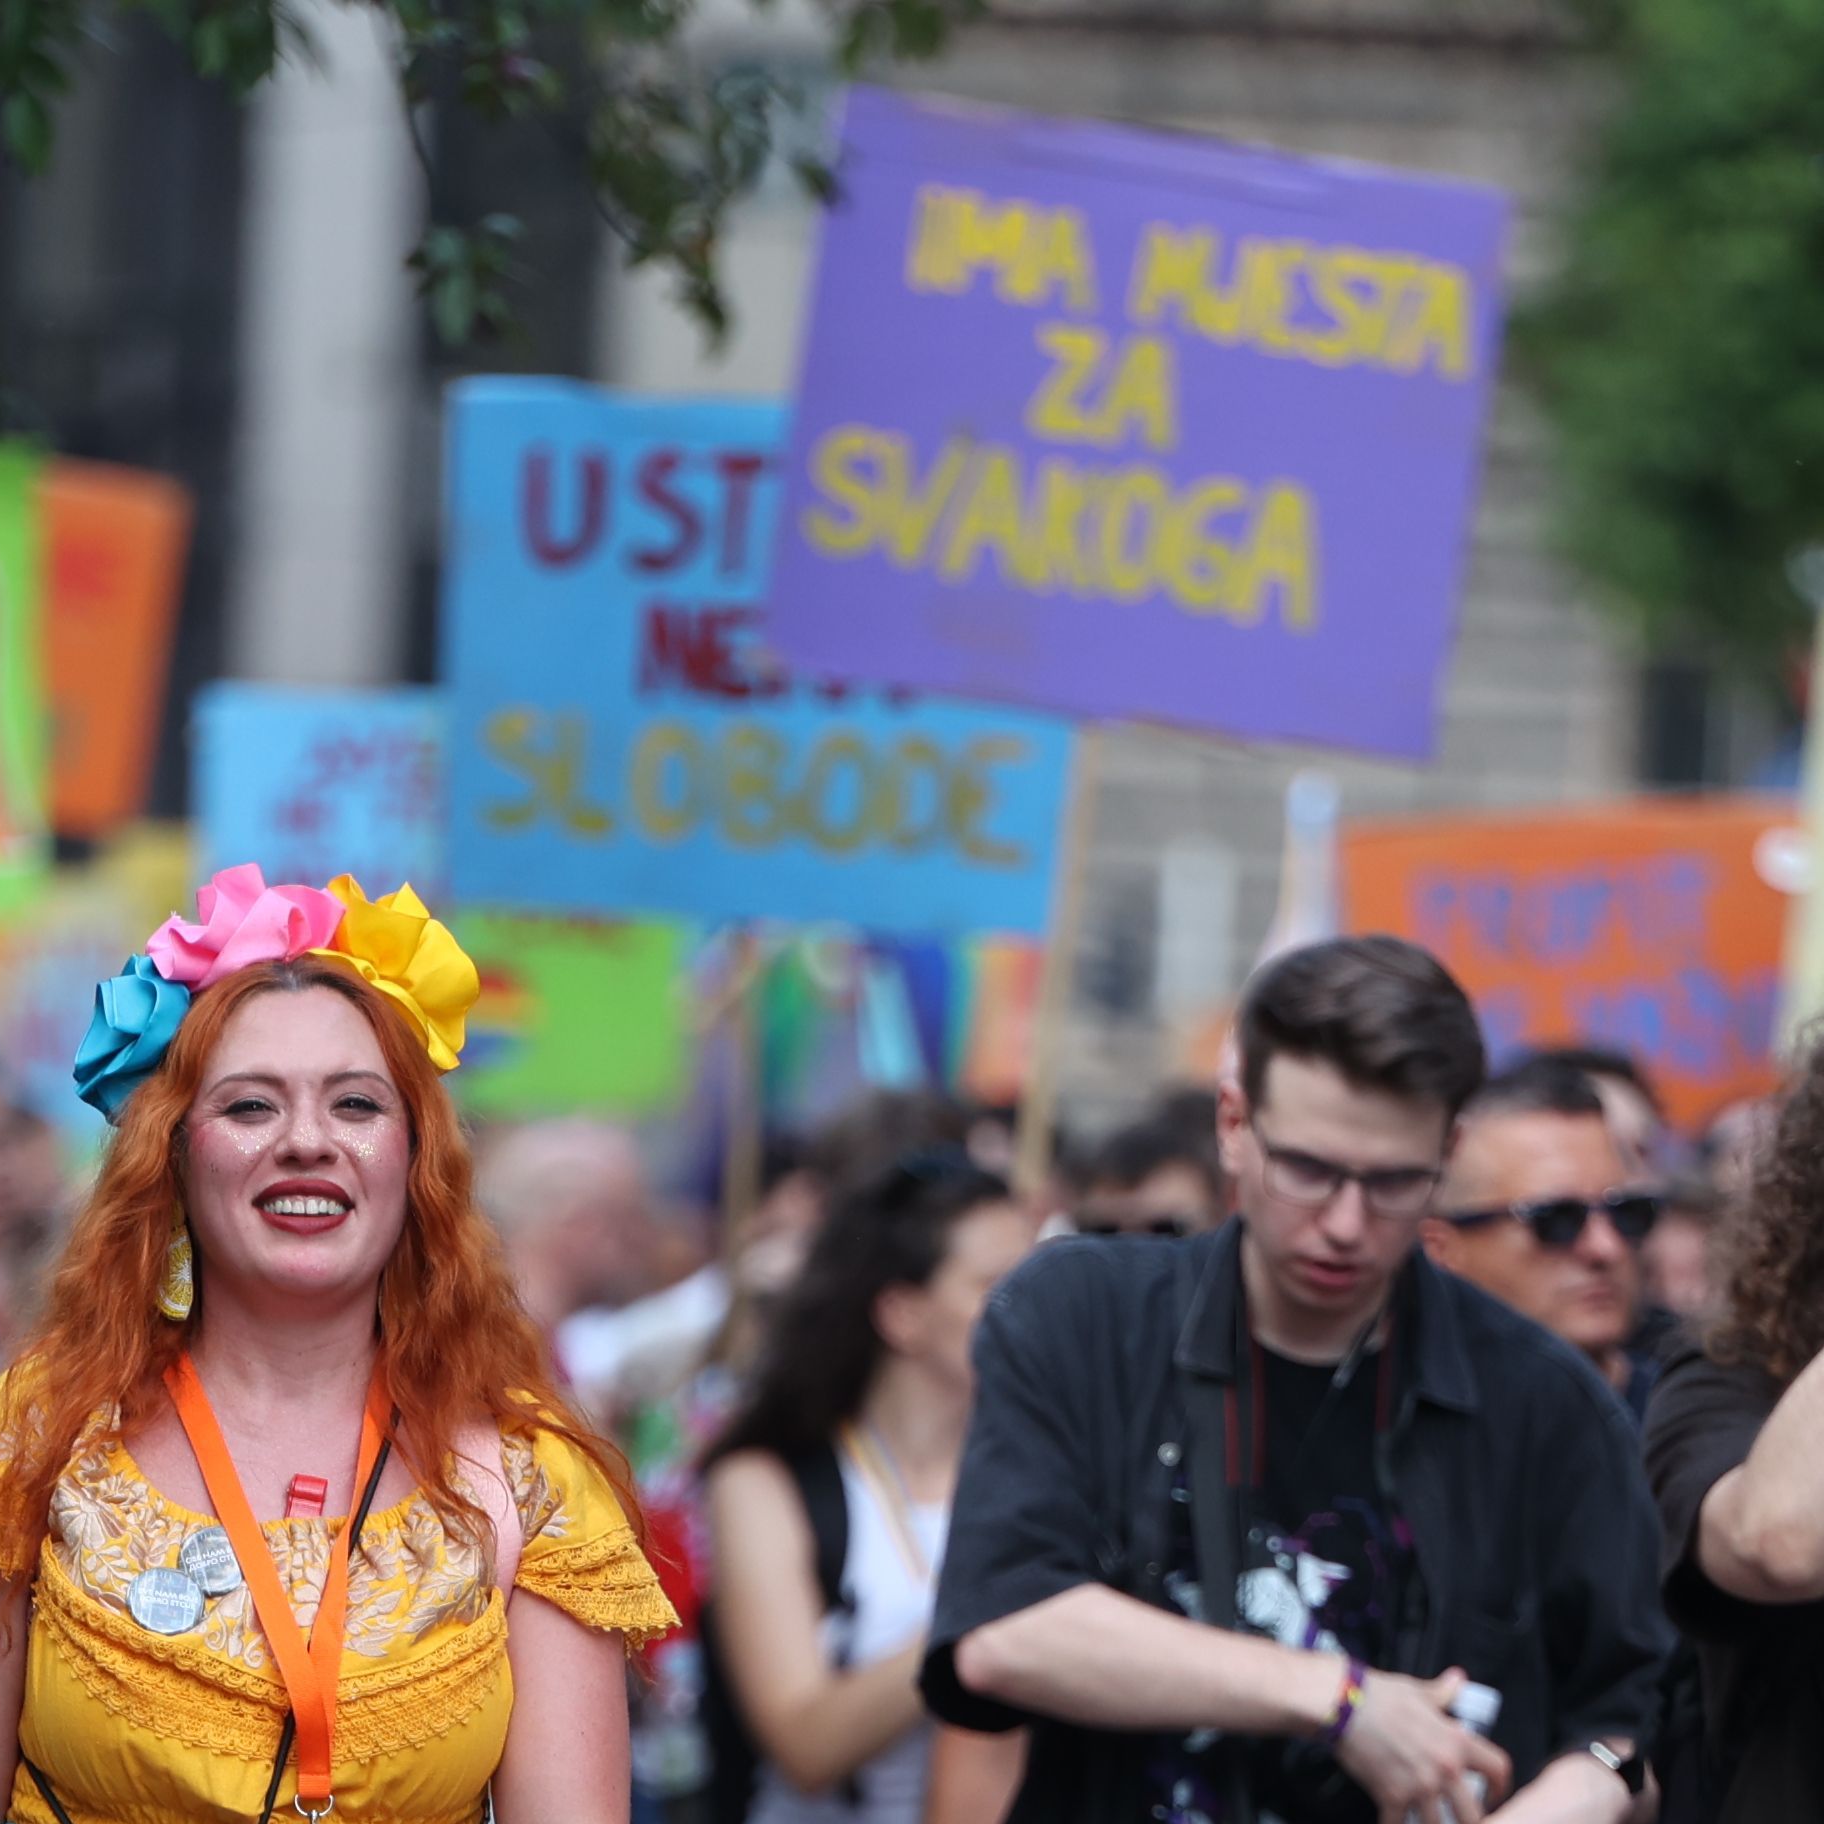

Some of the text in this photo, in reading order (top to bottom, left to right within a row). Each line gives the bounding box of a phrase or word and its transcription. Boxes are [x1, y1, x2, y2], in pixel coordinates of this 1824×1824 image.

[911, 189, 1466, 376] IMA MJESTA
[1031, 328, 1174, 446] ZA
[526, 445, 780, 575] UST
[806, 428, 1313, 632] SVAKOGA
[486, 706, 1031, 861] SLOBODE
